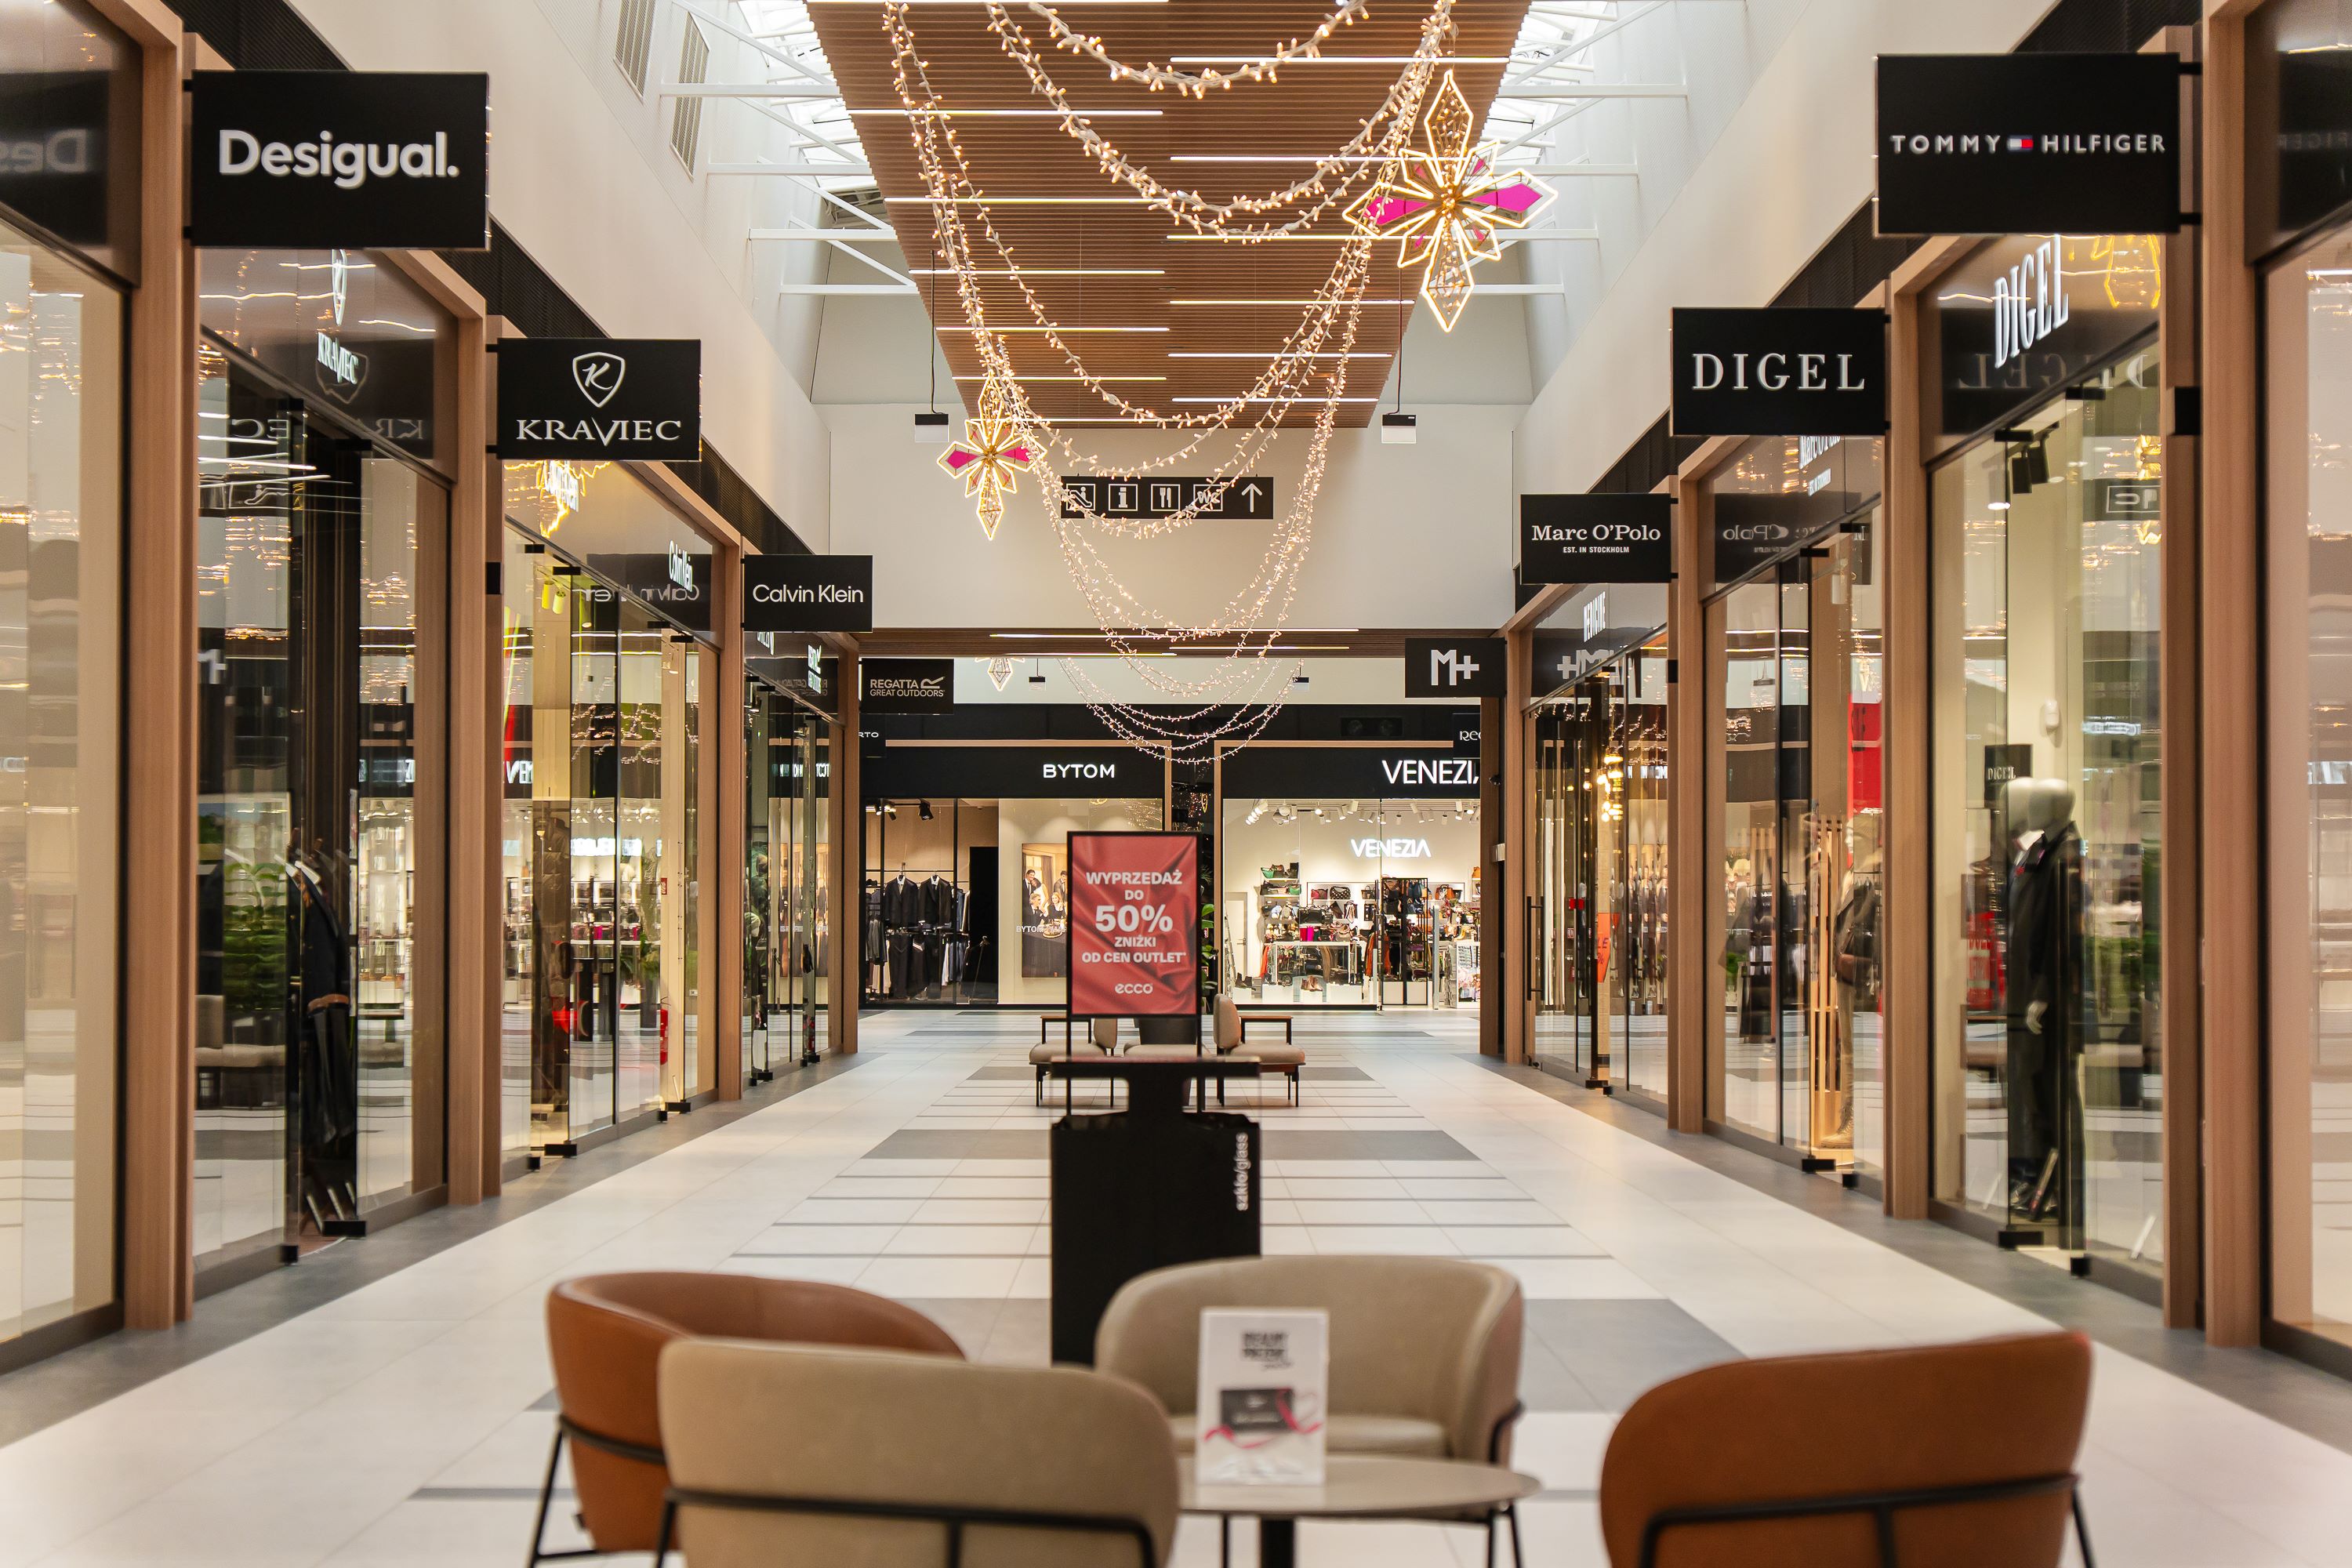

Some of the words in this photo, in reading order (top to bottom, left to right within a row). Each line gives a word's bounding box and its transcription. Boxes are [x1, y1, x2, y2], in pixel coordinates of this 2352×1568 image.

[1889, 134, 2001, 154] TOMMY
[2041, 134, 2166, 154] HILFIGER
[219, 129, 459, 189] Desigual.
[1994, 234, 2069, 369] DIGEL
[1692, 353, 1865, 390] DIGEL
[516, 417, 681, 447] KRAVIEC
[1531, 525, 1587, 541] Marc
[1592, 524, 1661, 541] O'Polo
[753, 584, 814, 603] Calvin
[818, 584, 864, 603] Klein
[1431, 649, 1480, 686] M+
[870, 679, 919, 688] REGATTA
[1043, 764, 1115, 779] BYTOM
[1381, 760, 1479, 784] VENEZI
[1351, 839, 1432, 858] VENEZIA
[1086, 869, 1182, 885] WYPRZEDAŻ
[1124, 890, 1144, 901] DO
[1095, 904, 1174, 933] 50%
[1114, 935, 1156, 948] ZNIŻKI
[1082, 952, 1101, 963] OD
[1103, 952, 1131, 963] CEN
[1114, 983, 1153, 994] ecco
